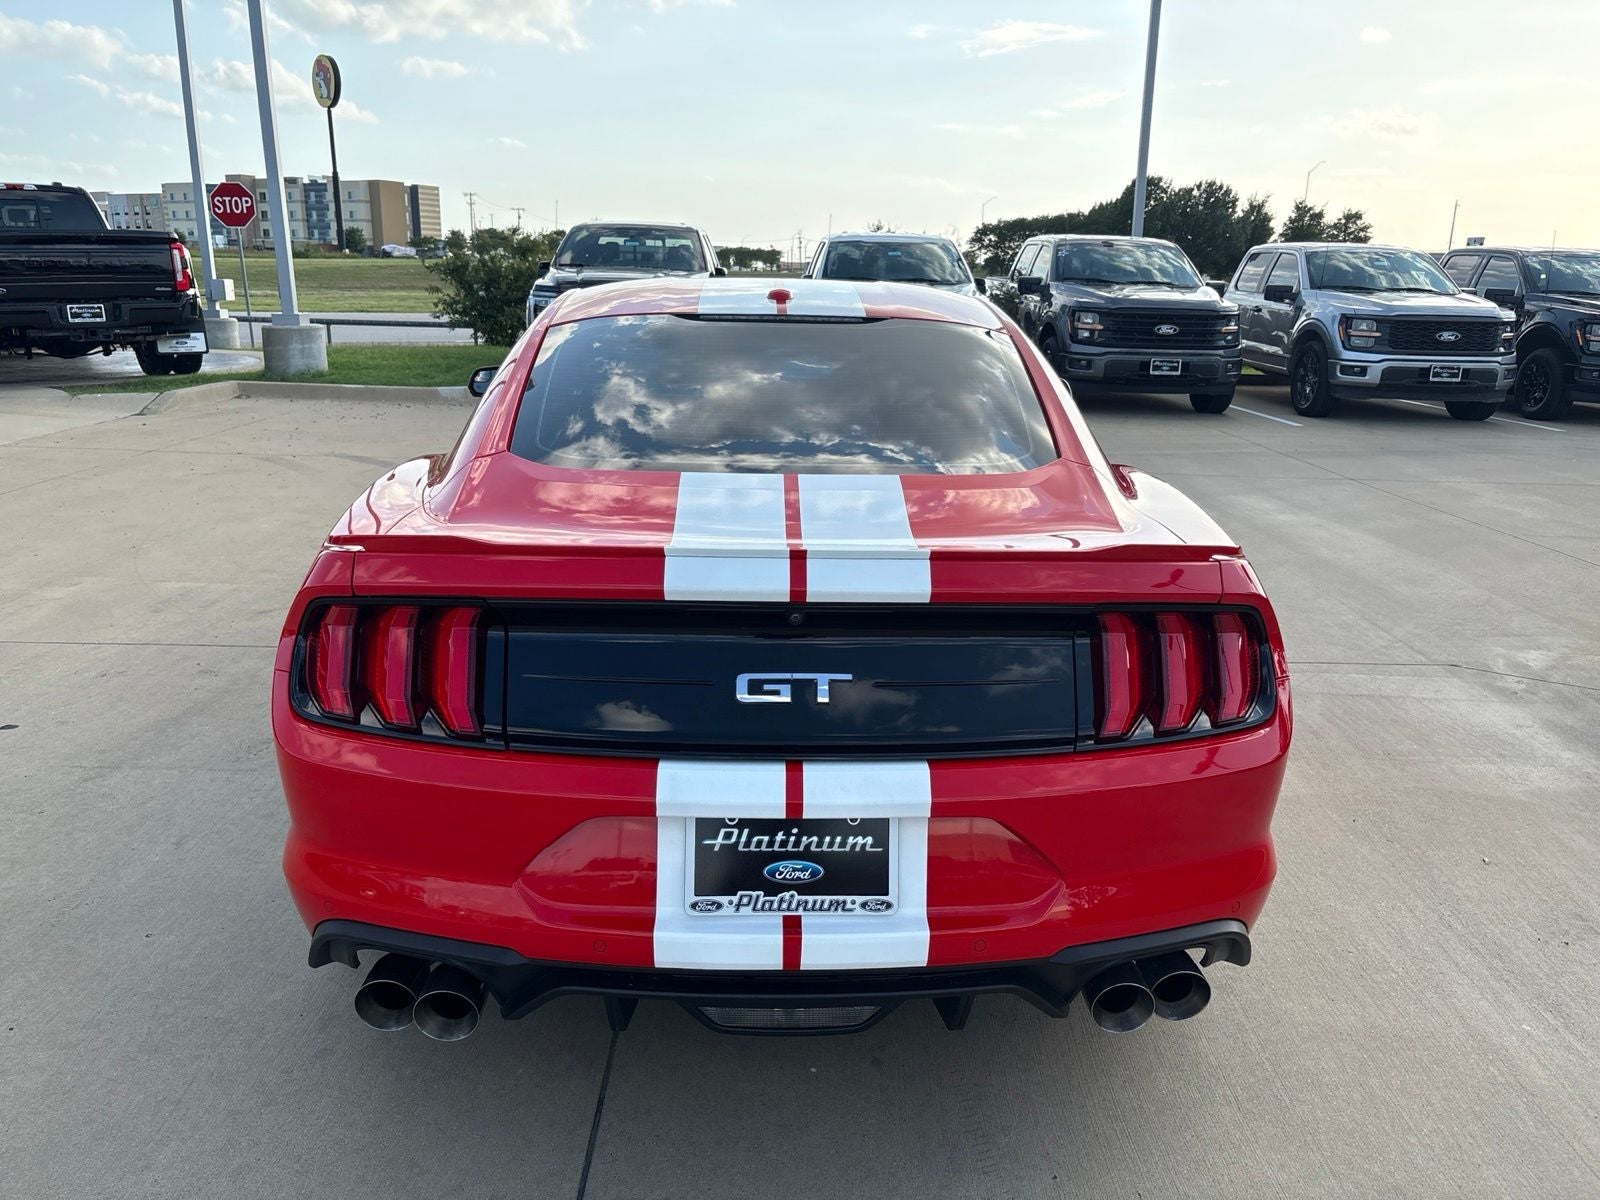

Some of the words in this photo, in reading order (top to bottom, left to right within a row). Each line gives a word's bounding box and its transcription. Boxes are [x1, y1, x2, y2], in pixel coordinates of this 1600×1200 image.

[213, 196, 252, 214] STOP
[1158, 326, 1176, 334] Ford
[1439, 332, 1457, 340] Ford
[736, 673, 853, 703] GT
[702, 827, 883, 851] Platinum
[775, 864, 812, 880] Ford
[694, 900, 718, 911] Ford
[734, 891, 857, 913] Platinum
[864, 900, 888, 911] Ford
